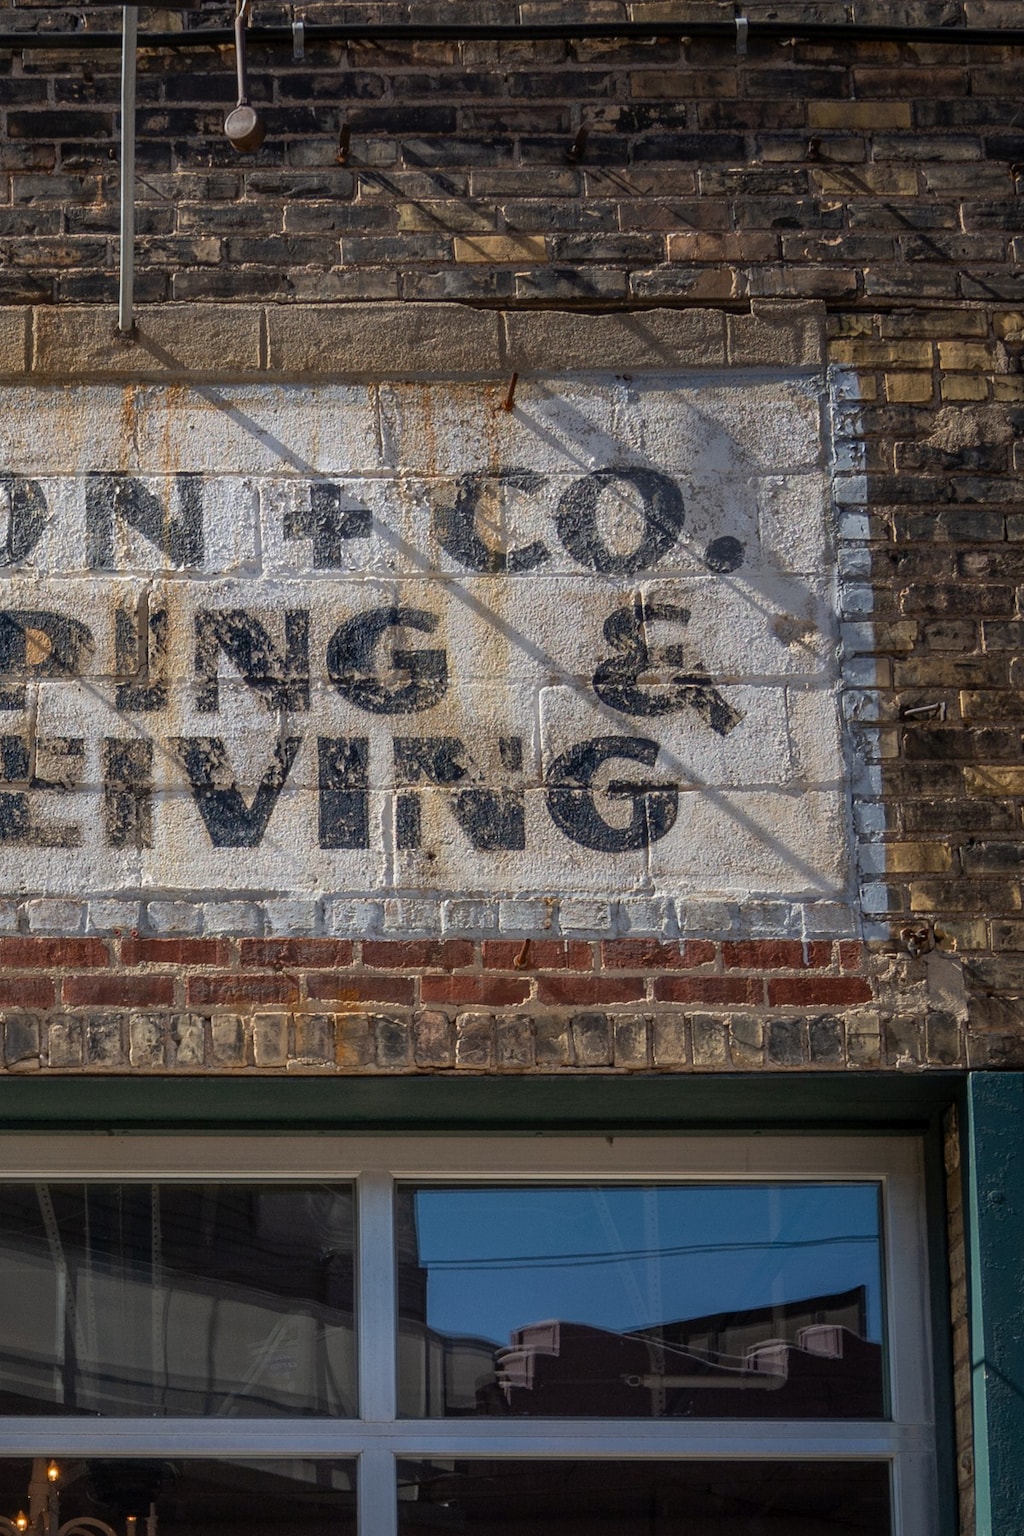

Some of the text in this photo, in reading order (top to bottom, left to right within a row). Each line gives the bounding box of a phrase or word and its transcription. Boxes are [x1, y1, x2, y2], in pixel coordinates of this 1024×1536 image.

[282, 482, 372, 570] +
[434, 466, 746, 574] CO.
[593, 603, 742, 737] &
